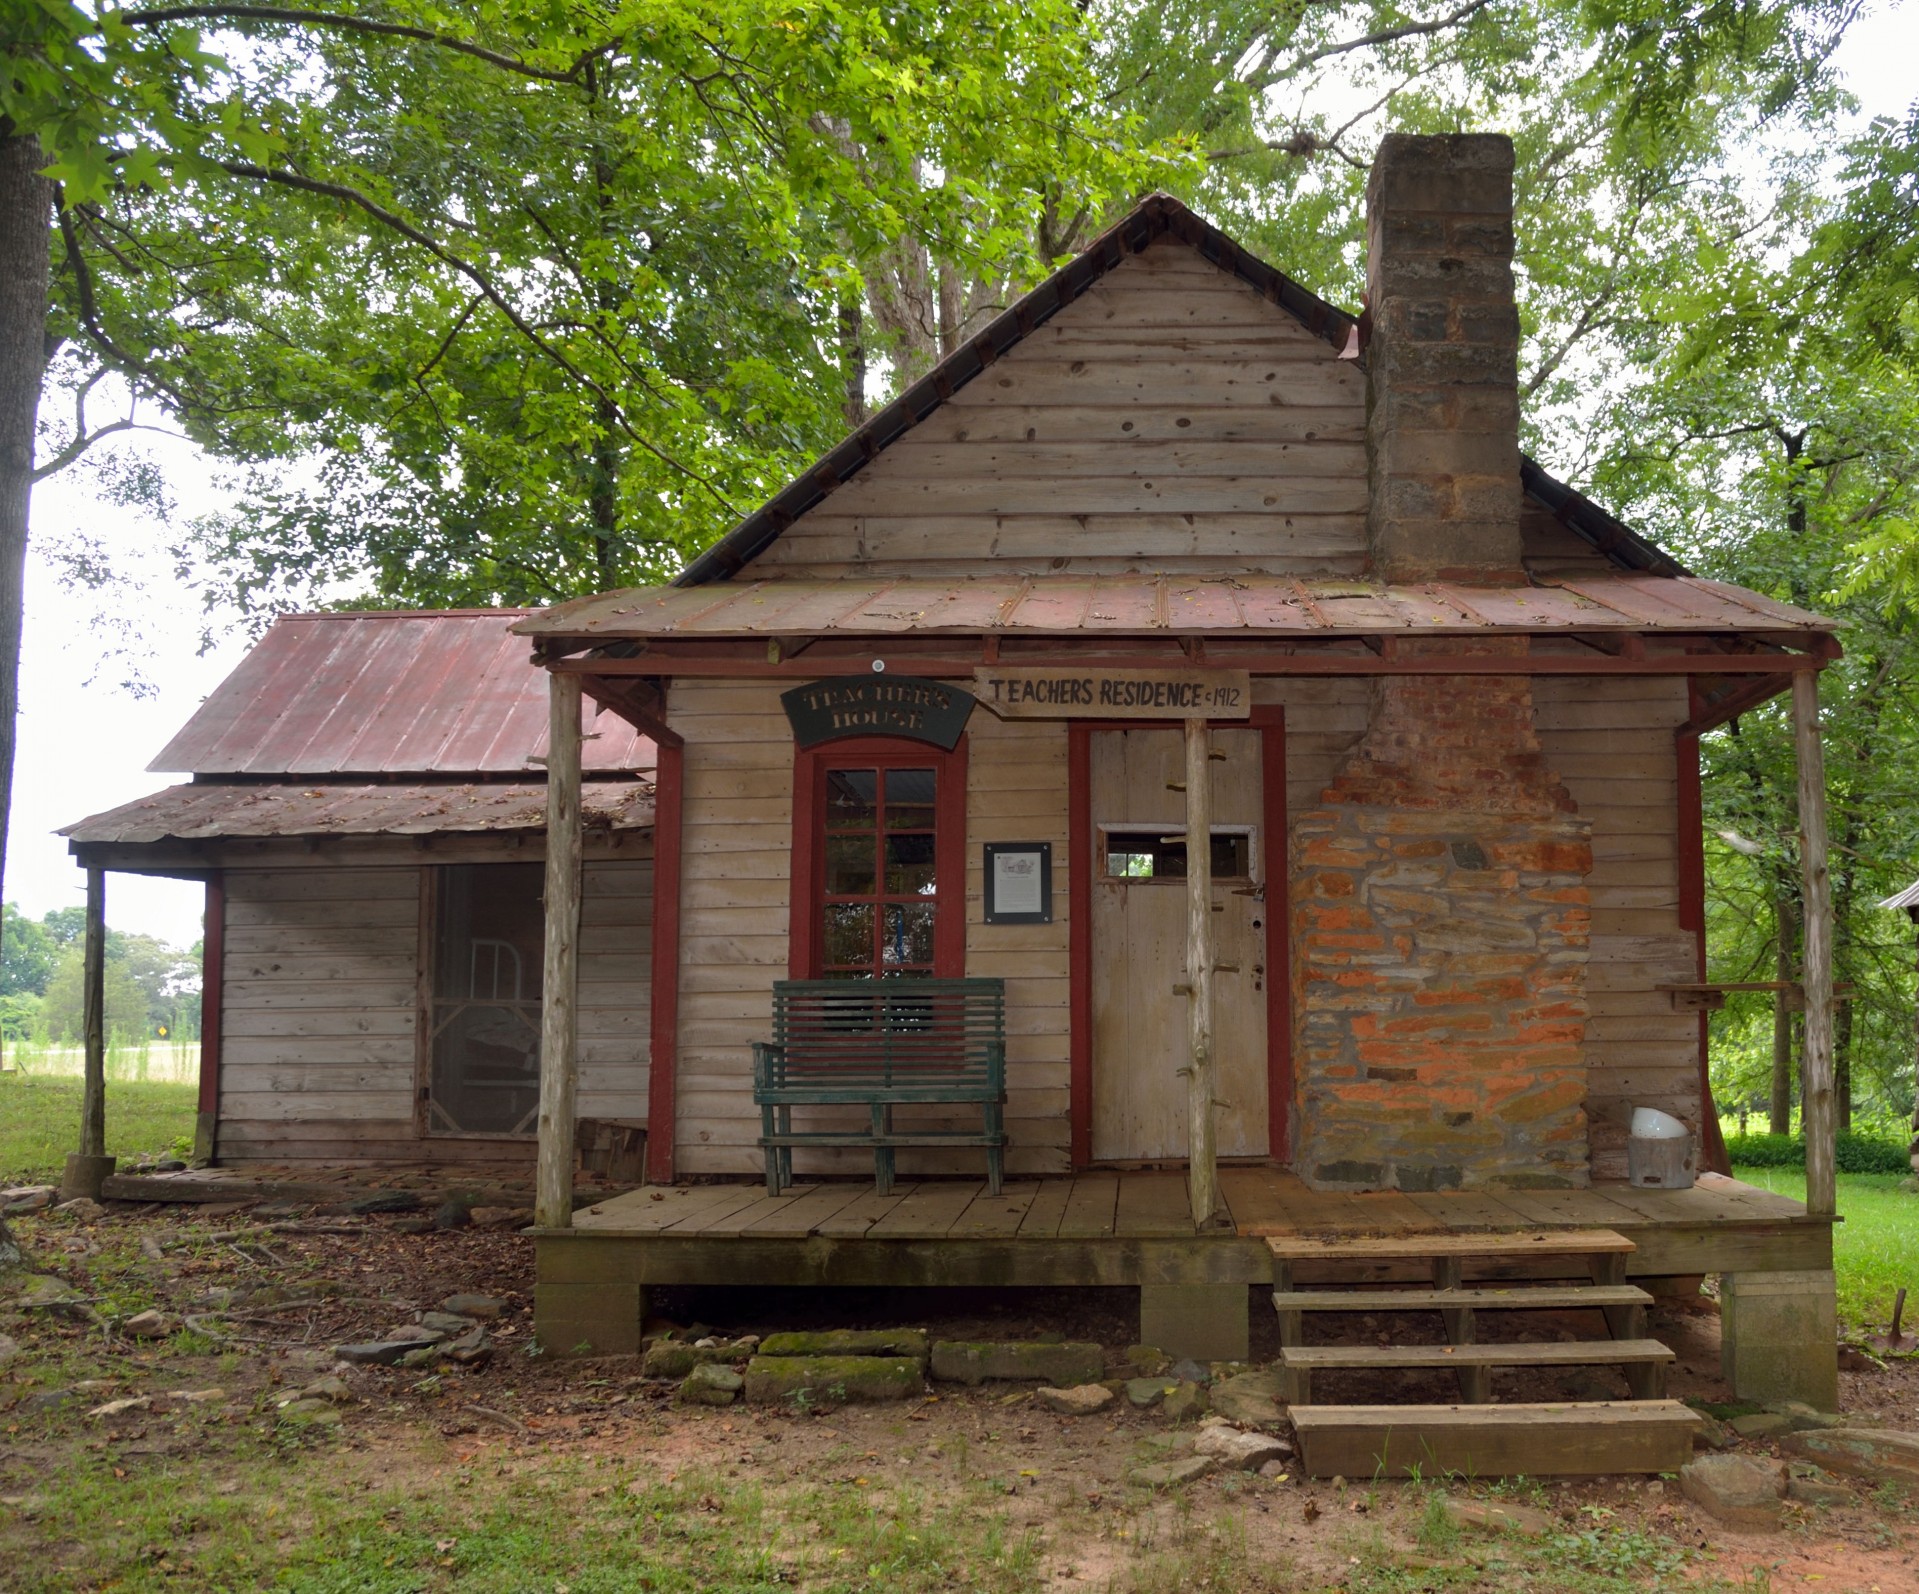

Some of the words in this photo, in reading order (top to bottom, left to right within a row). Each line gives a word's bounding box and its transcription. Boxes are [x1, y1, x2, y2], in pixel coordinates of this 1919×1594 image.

[988, 679, 1094, 705] TEACHERS
[1099, 679, 1204, 707] RESIDENCE
[832, 709, 924, 730] HOUSE
